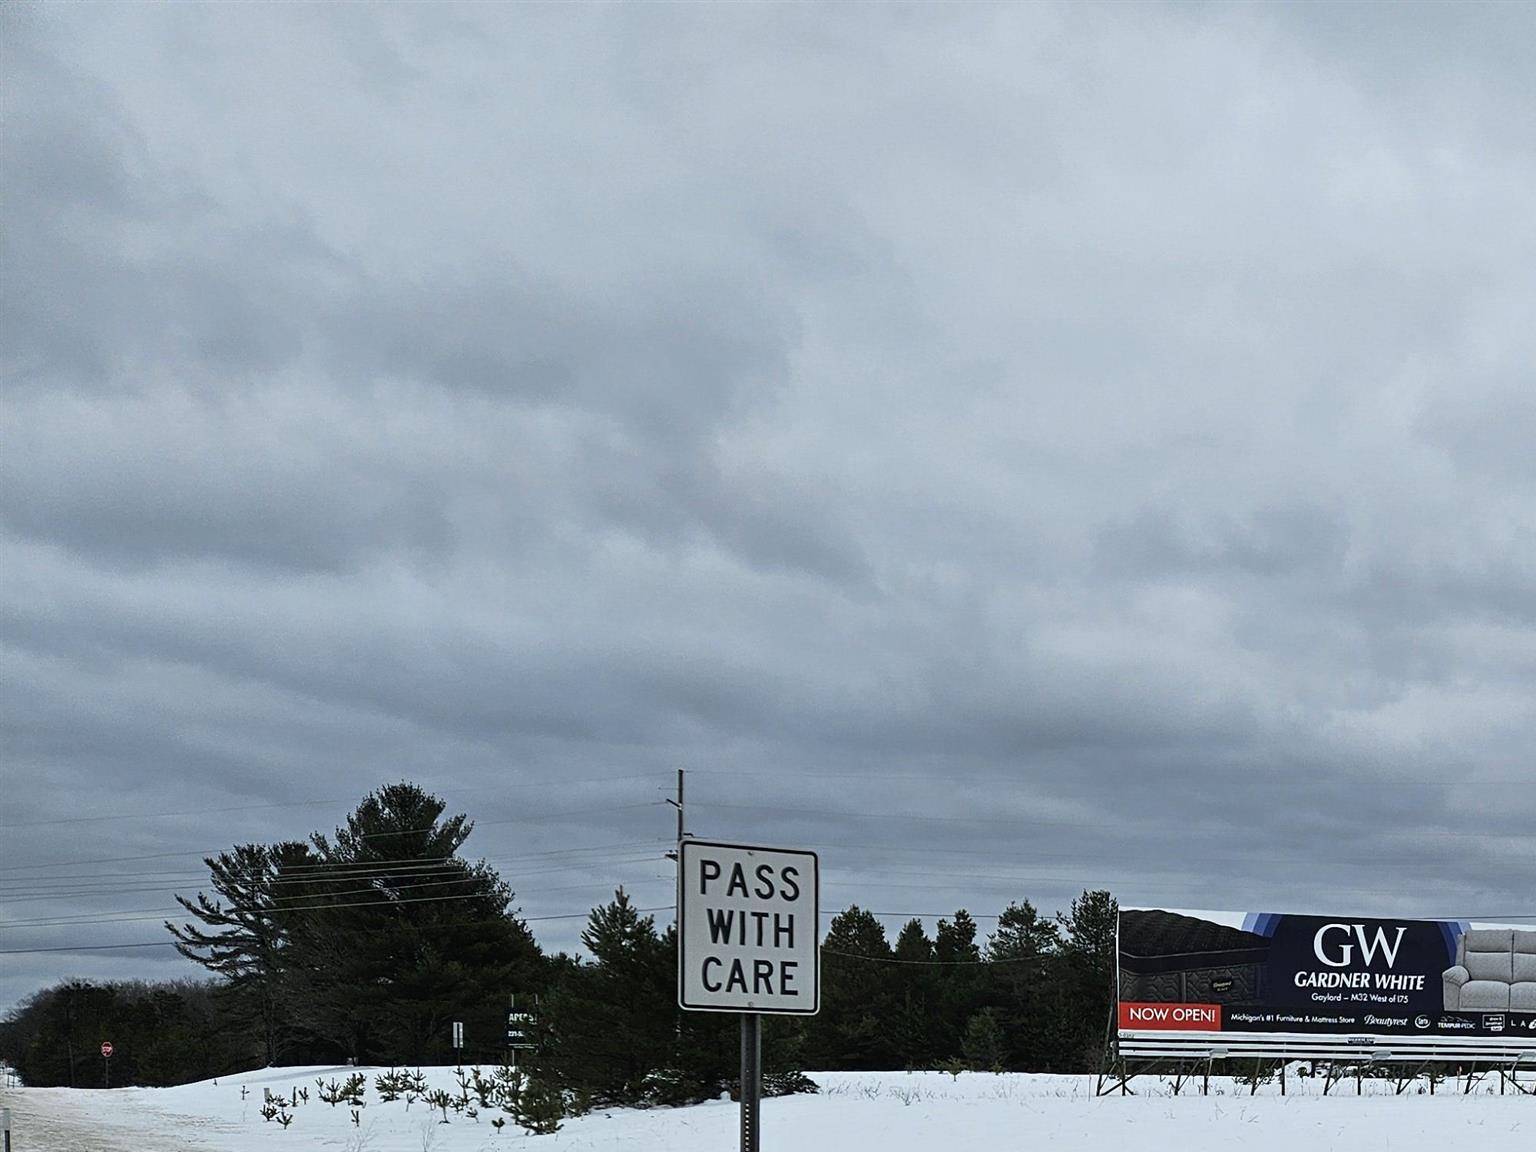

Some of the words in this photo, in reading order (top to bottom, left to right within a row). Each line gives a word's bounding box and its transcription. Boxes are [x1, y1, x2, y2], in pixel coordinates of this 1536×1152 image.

[700, 859, 800, 901] PASS
[706, 908, 794, 948] WITH
[1313, 923, 1407, 969] GW
[702, 956, 798, 996] CARE
[1294, 971, 1371, 988] GARDNER
[1375, 973, 1425, 990] WHITE
[1311, 992, 1342, 1003] Gaylord
[1351, 993, 1368, 1001] M32
[1369, 994, 1387, 1003] West
[1388, 995, 1396, 1003] of
[1129, 1007, 1169, 1021] NOW
[1172, 1008, 1215, 1023] OPEN!
[1231, 1013, 1265, 1023] Michigan's
[1276, 1014, 1303, 1023] Furniture
[1363, 1014, 1408, 1027] Beautyrest
